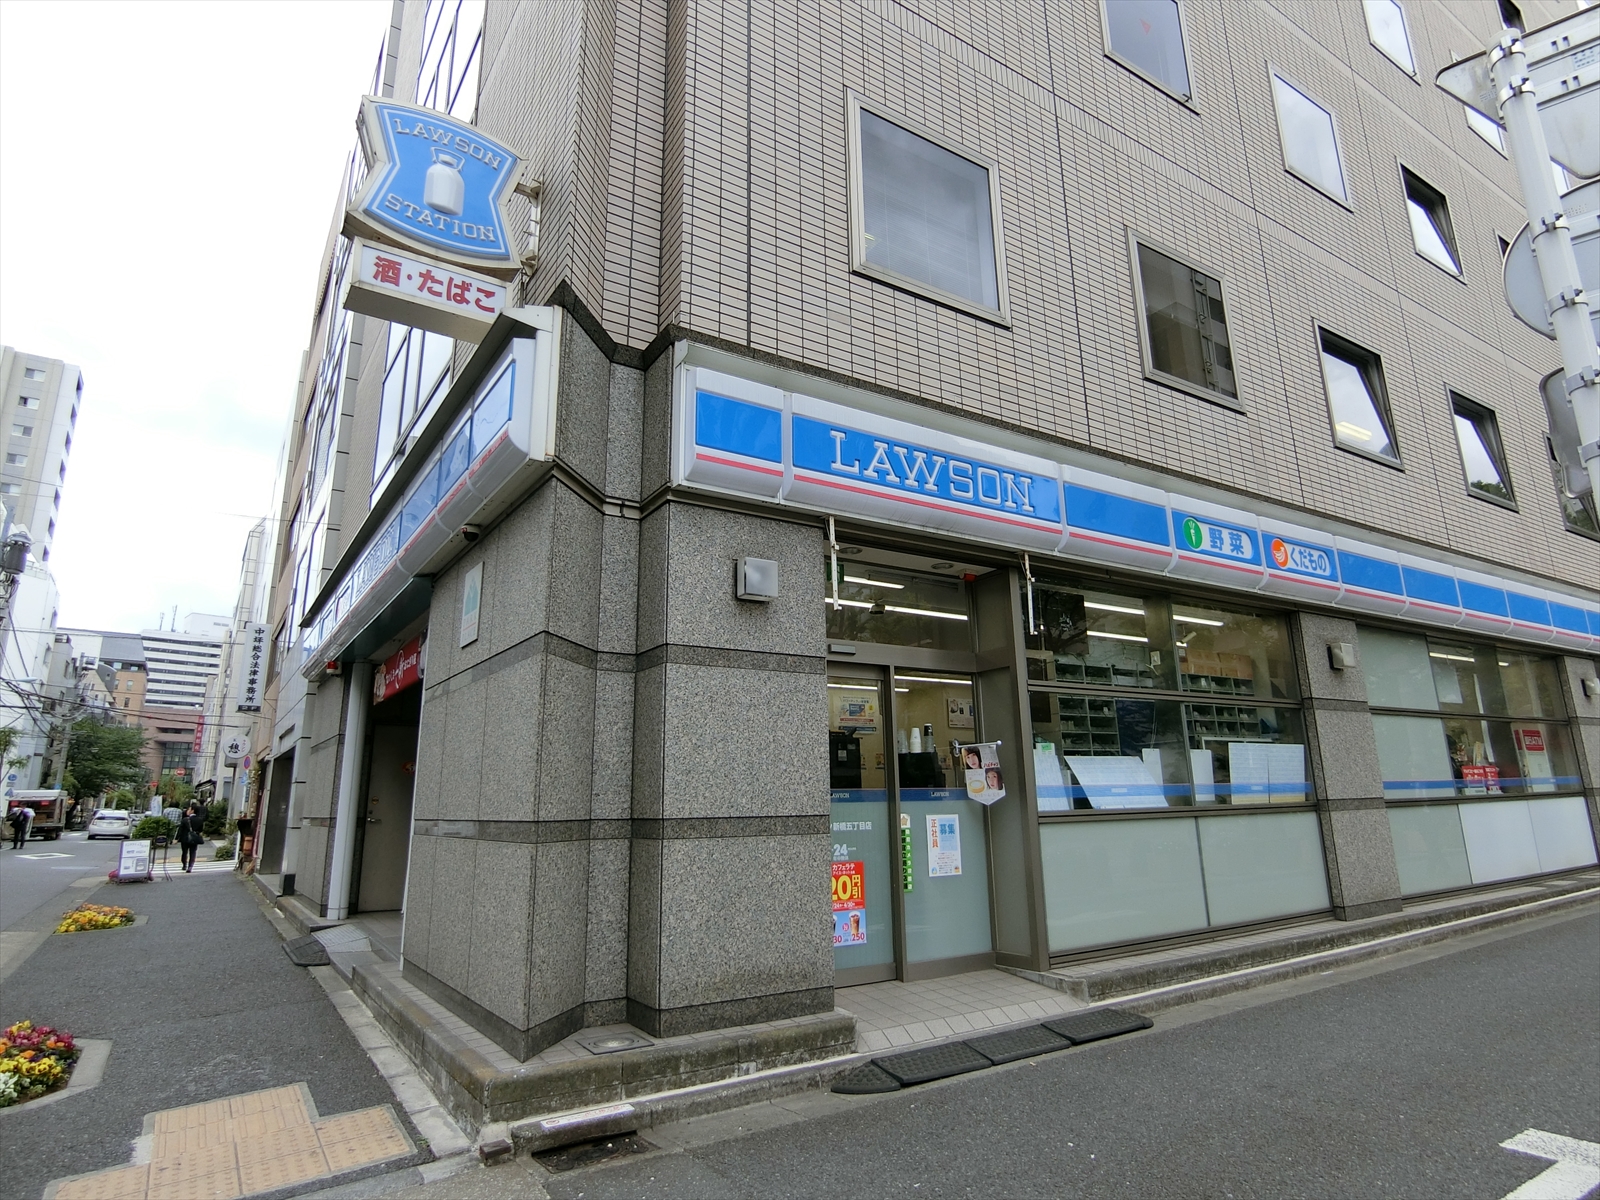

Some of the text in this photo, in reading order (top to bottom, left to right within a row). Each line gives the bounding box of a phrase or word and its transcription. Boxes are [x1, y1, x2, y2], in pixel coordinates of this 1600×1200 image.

[393, 118, 502, 171] LAWSON
[384, 192, 496, 242] STATION
[373, 255, 496, 313] 酒・たばこ
[829, 429, 1035, 514] LAWSON
[1208, 526, 1245, 556] 野菜
[1289, 546, 1329, 573] くだもの
[931, 818, 939, 848] 正社員
[940, 823, 955, 835] 募集
[833, 843, 848, 856] 24
[852, 874, 862, 899] 円引
[851, 931, 865, 942] 250
